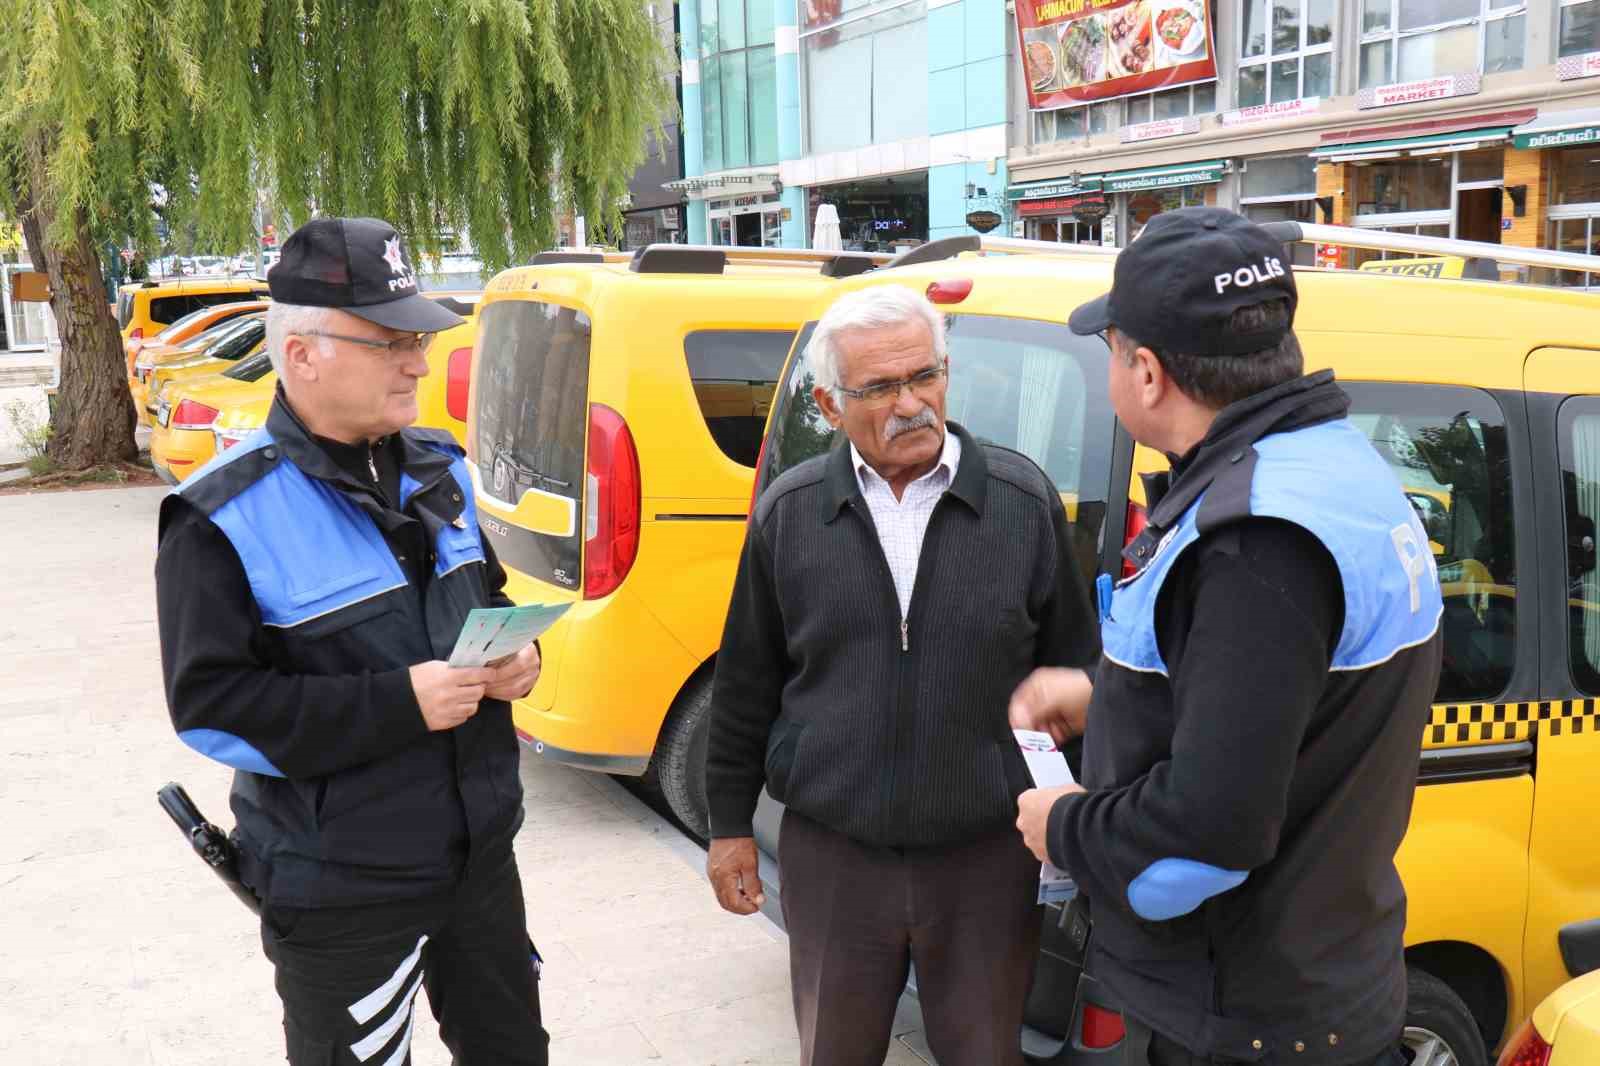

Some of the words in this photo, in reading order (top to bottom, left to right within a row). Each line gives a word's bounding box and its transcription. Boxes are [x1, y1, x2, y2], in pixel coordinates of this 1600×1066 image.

[1383, 88, 1447, 104] MARKET
[1240, 100, 1302, 118] YOZGATLILAR
[1214, 256, 1285, 294] POLİS
